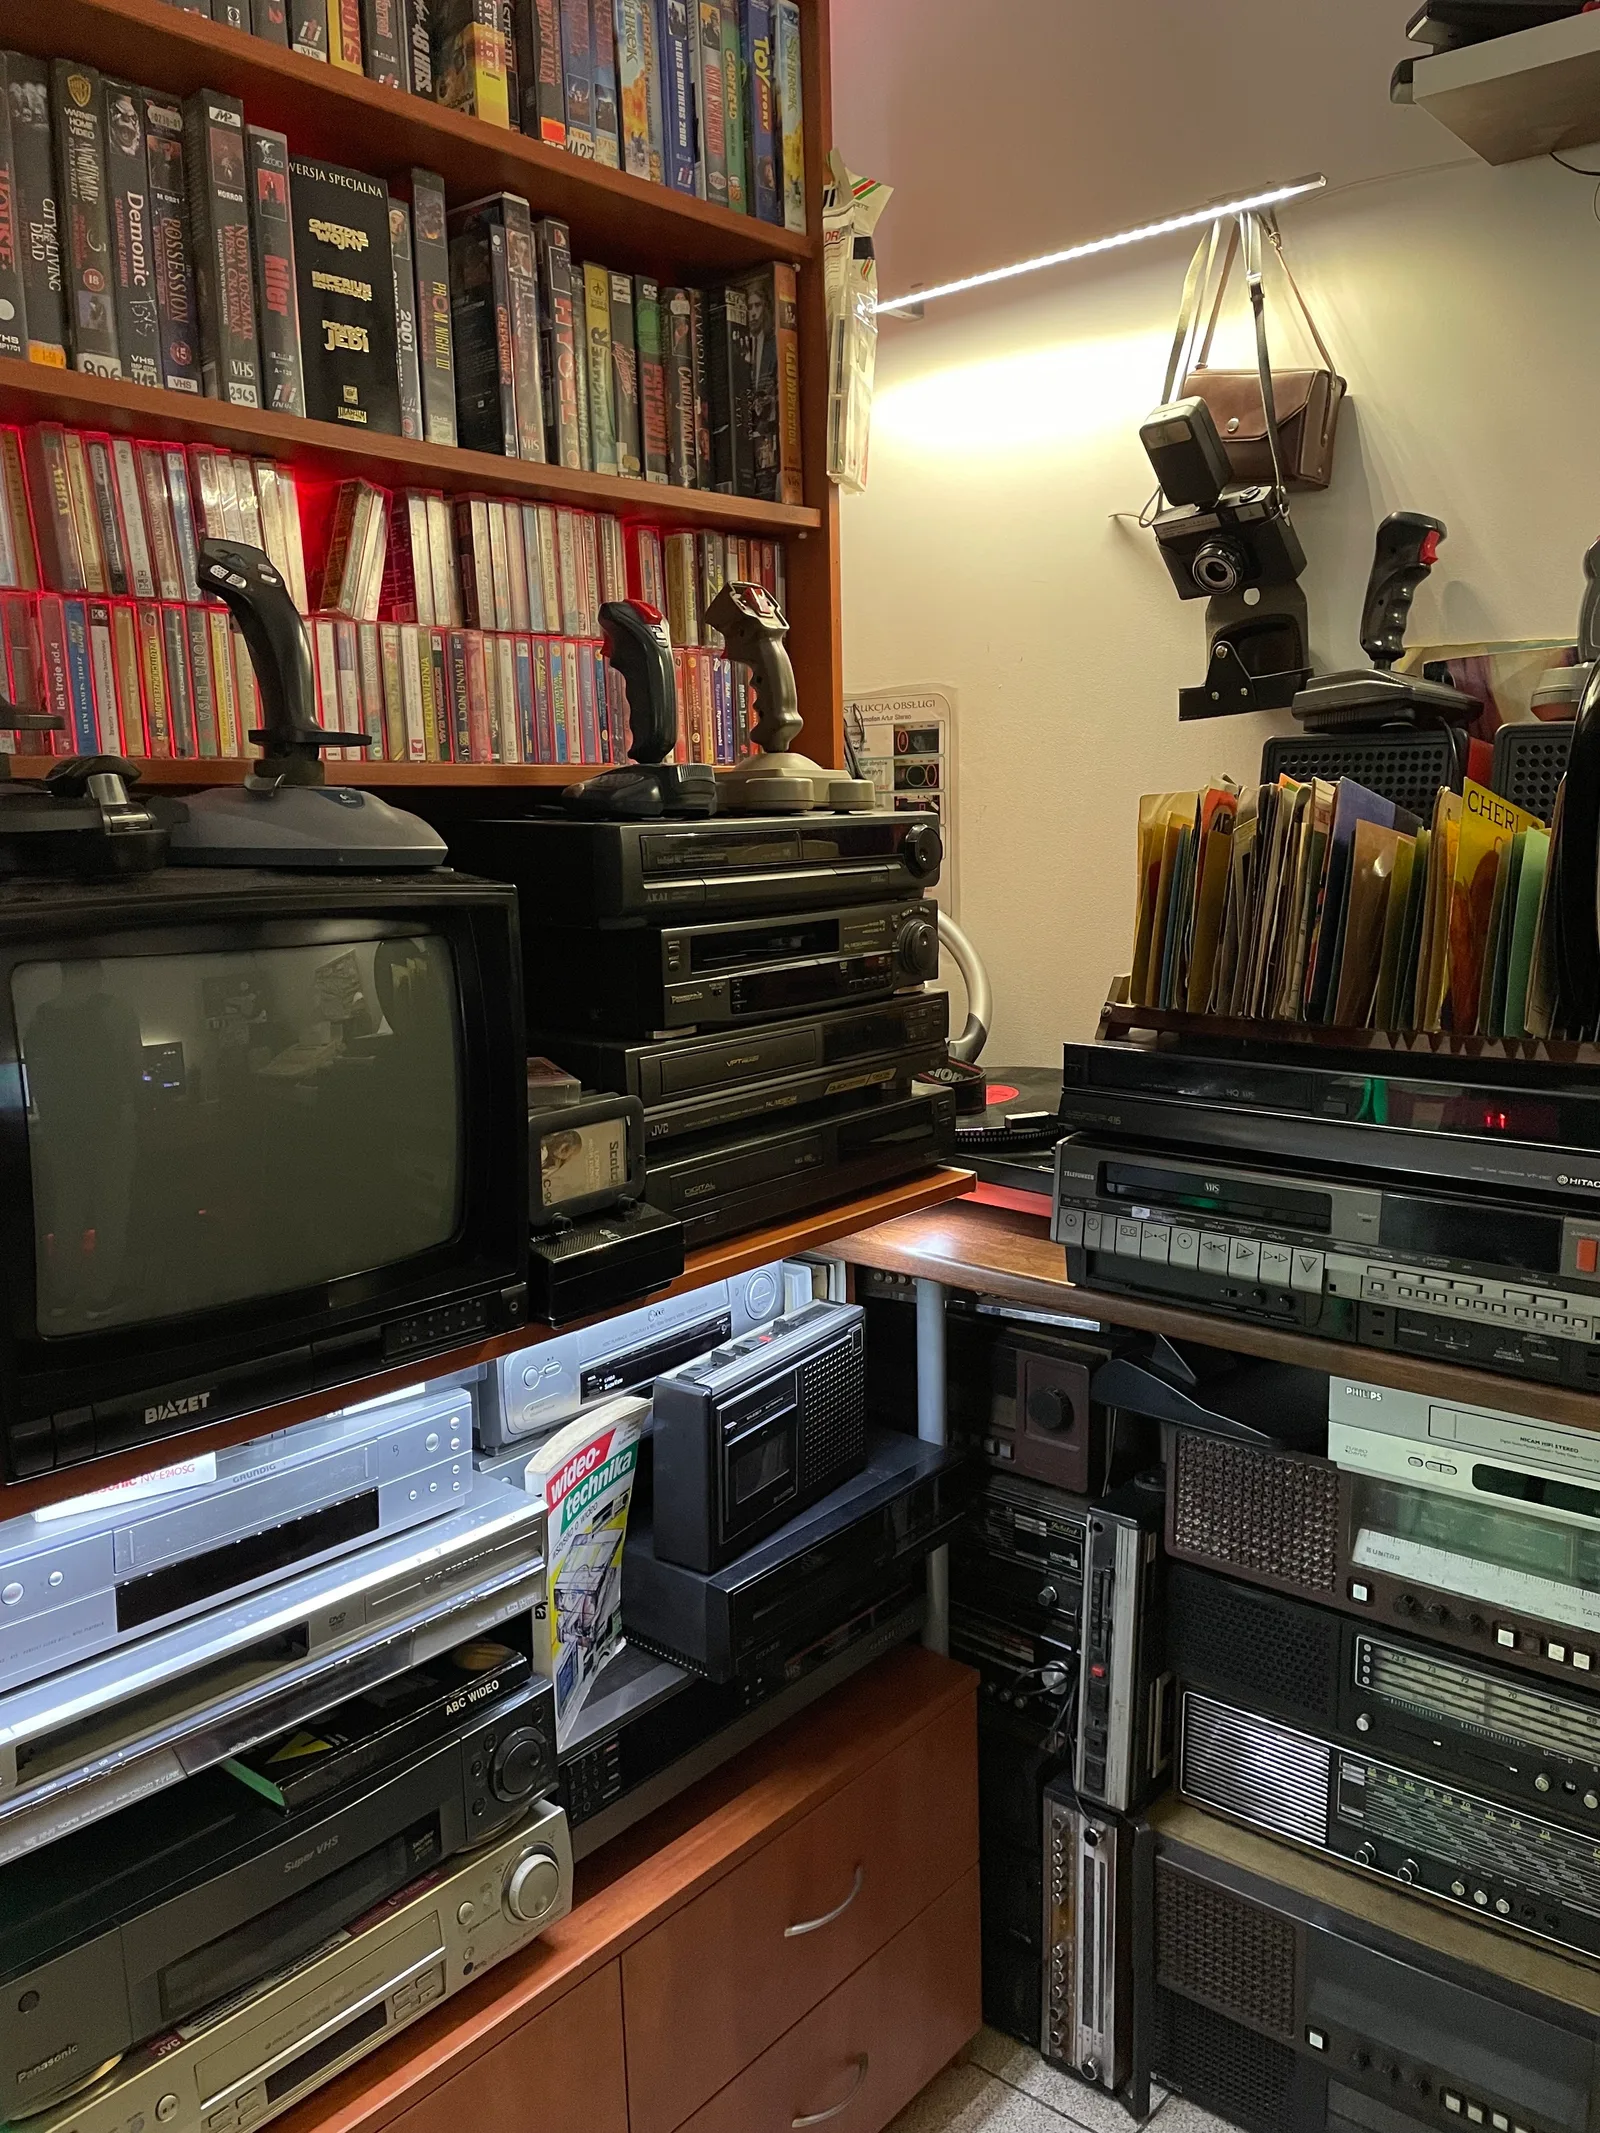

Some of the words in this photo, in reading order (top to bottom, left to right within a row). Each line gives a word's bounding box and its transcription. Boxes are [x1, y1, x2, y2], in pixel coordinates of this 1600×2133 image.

[675, 40, 684, 70] BLUES
[753, 35, 770, 91] TOY
[676, 72, 687, 121] BROTHERS
[723, 49, 738, 121] GARFIELD
[64, 106, 98, 123] WARNER
[760, 84, 772, 130] STORY
[69, 118, 94, 130] HOME
[69, 127, 96, 140] VIDEO
[678, 122, 688, 147] 2000
[217, 189, 244, 203] HORROR
[288, 161, 327, 182] WERSJA
[328, 172, 384, 200] SPECJALNA
[42, 198, 58, 234] CITY
[30, 222, 45, 262] DEAD
[127, 190, 150, 288] Demonic
[223, 225, 236, 264] WESA
[234, 222, 248, 271] NOWY
[316, 229, 370, 252] WOJNY
[45, 244, 62, 292] LIVING
[88, 274, 100, 285] 18
[161, 217, 189, 323] POSSESSION
[311, 271, 373, 293] IMPERIUM
[226, 266, 242, 334] CRAVENA
[238, 271, 254, 341] KOSZMAR
[431, 280, 449, 324] PROM
[323, 328, 371, 354] JEDI
[399, 310, 414, 352] 2001
[434, 325, 450, 357] NIGHT
[496, 305, 511, 374] CREEPSHOW
[693, 300, 707, 386] STIGMATA
[131, 354, 155, 366] VHS
[231, 360, 255, 378] VHS
[173, 378, 192, 390] VHS
[229, 385, 256, 404] 2969
[676, 365, 694, 443] CANDYMAN
[51, 642, 62, 663] ad.4
[191, 630, 208, 682] MONA
[361, 634, 377, 684] MAXI
[53, 664, 65, 692] troje
[454, 658, 465, 694] PEWNEJ
[56, 692, 66, 711] ich
[196, 689, 211, 723] LISA
[457, 695, 468, 727] NOCY
[892, 699, 936, 711] OBSŁUGI
[647, 892, 669, 902] AKAI
[671, 990, 704, 1005] Panasonic
[1226, 1088, 1240, 1098] HQ
[650, 1122, 670, 1137] JVC
[684, 1181, 716, 1196] DIGITAL
[1063, 1169, 1095, 1182] TELEFUNKEN
[1204, 1182, 1221, 1195] VHS
[144, 1391, 211, 1426] BIAZET
[1345, 1386, 1383, 1402] PHILIPS
[1345, 1444, 1369, 1454] TURBO
[1519, 1436, 1540, 1446] NICAM
[1554, 1443, 1579, 1454] STEREO
[140, 1463, 196, 1483] NV-E240SG
[232, 1463, 277, 1484] GRUNDIG
[550, 1447, 601, 1505] wideo-
[565, 1450, 633, 1521] technika
[445, 1696, 467, 1716] ABC
[468, 1679, 500, 1704] WIDEO
[283, 1850, 317, 1873] Super
[316, 1834, 340, 1855] VHS
[156, 2037, 181, 2057] JVC
[16, 2044, 79, 2085] Panasonic
